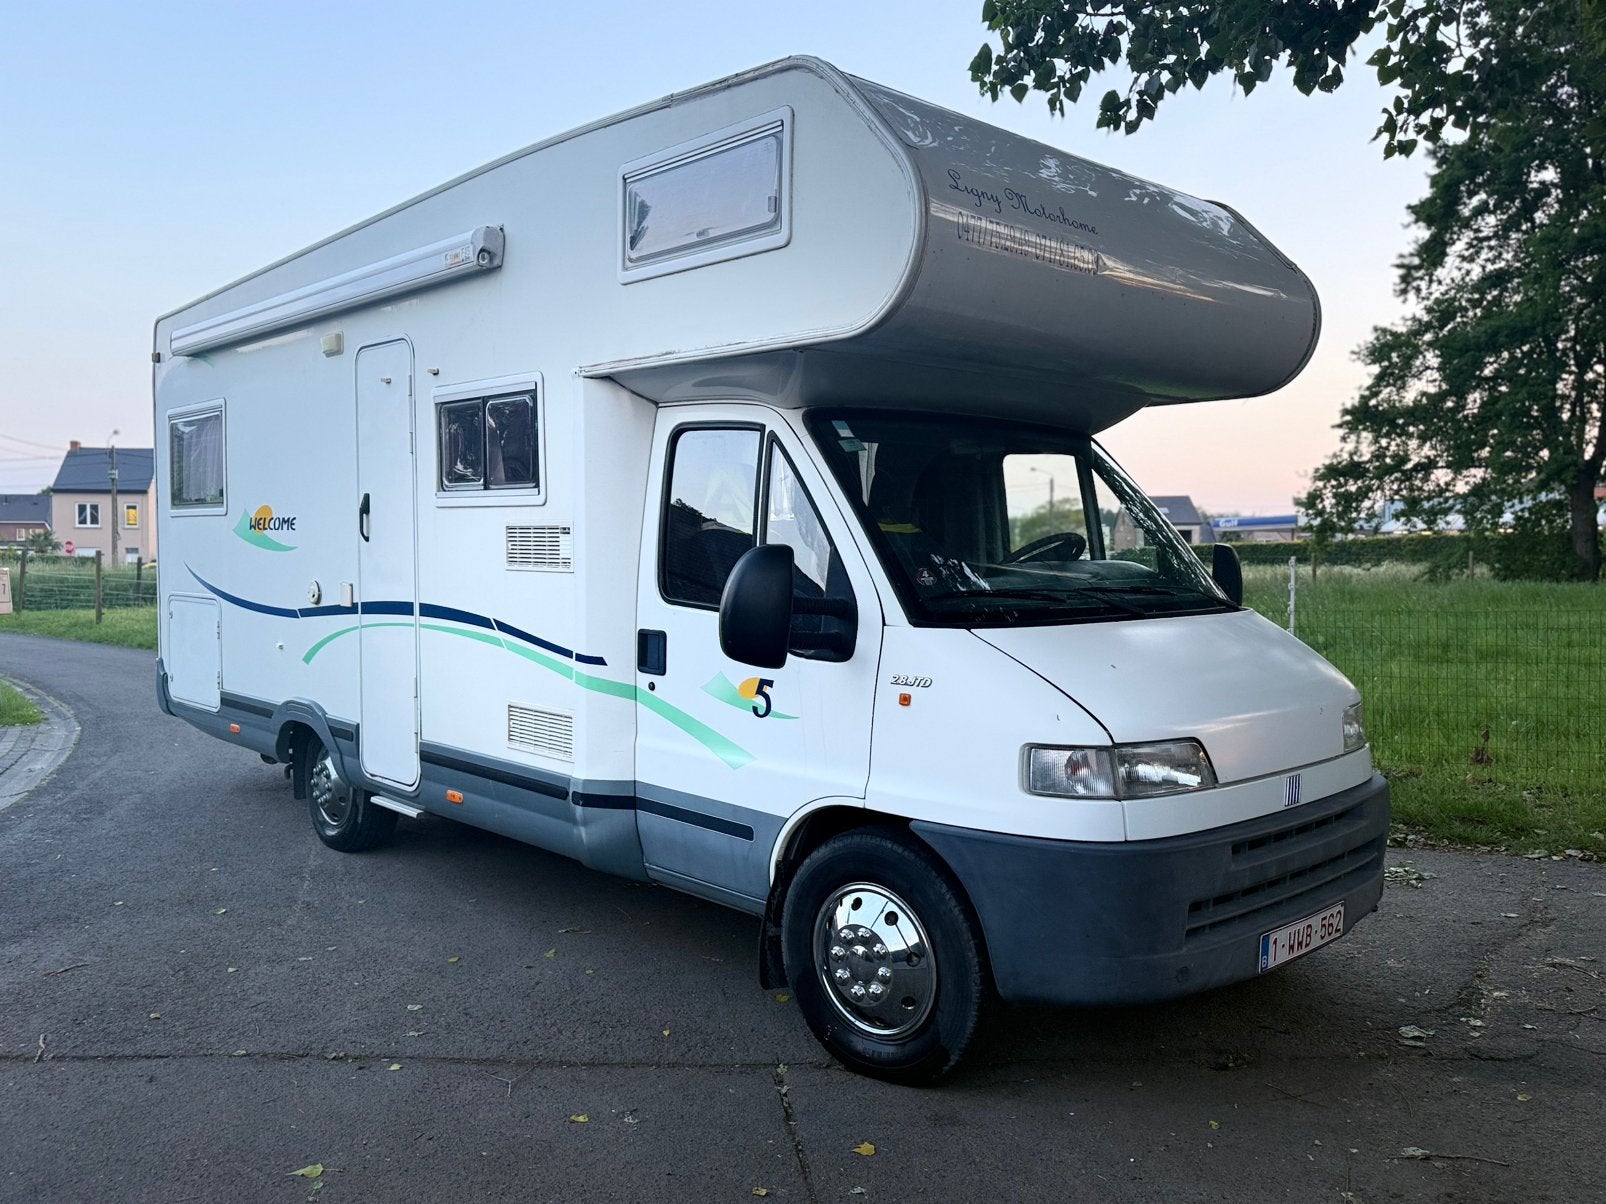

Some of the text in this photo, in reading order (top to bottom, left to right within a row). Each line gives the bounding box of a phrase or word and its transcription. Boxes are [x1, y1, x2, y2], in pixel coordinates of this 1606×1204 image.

[947, 168, 1001, 213] Ligny
[249, 516, 296, 531] WELCOME
[752, 678, 774, 719] 5
[1261, 955, 1268, 968] B
